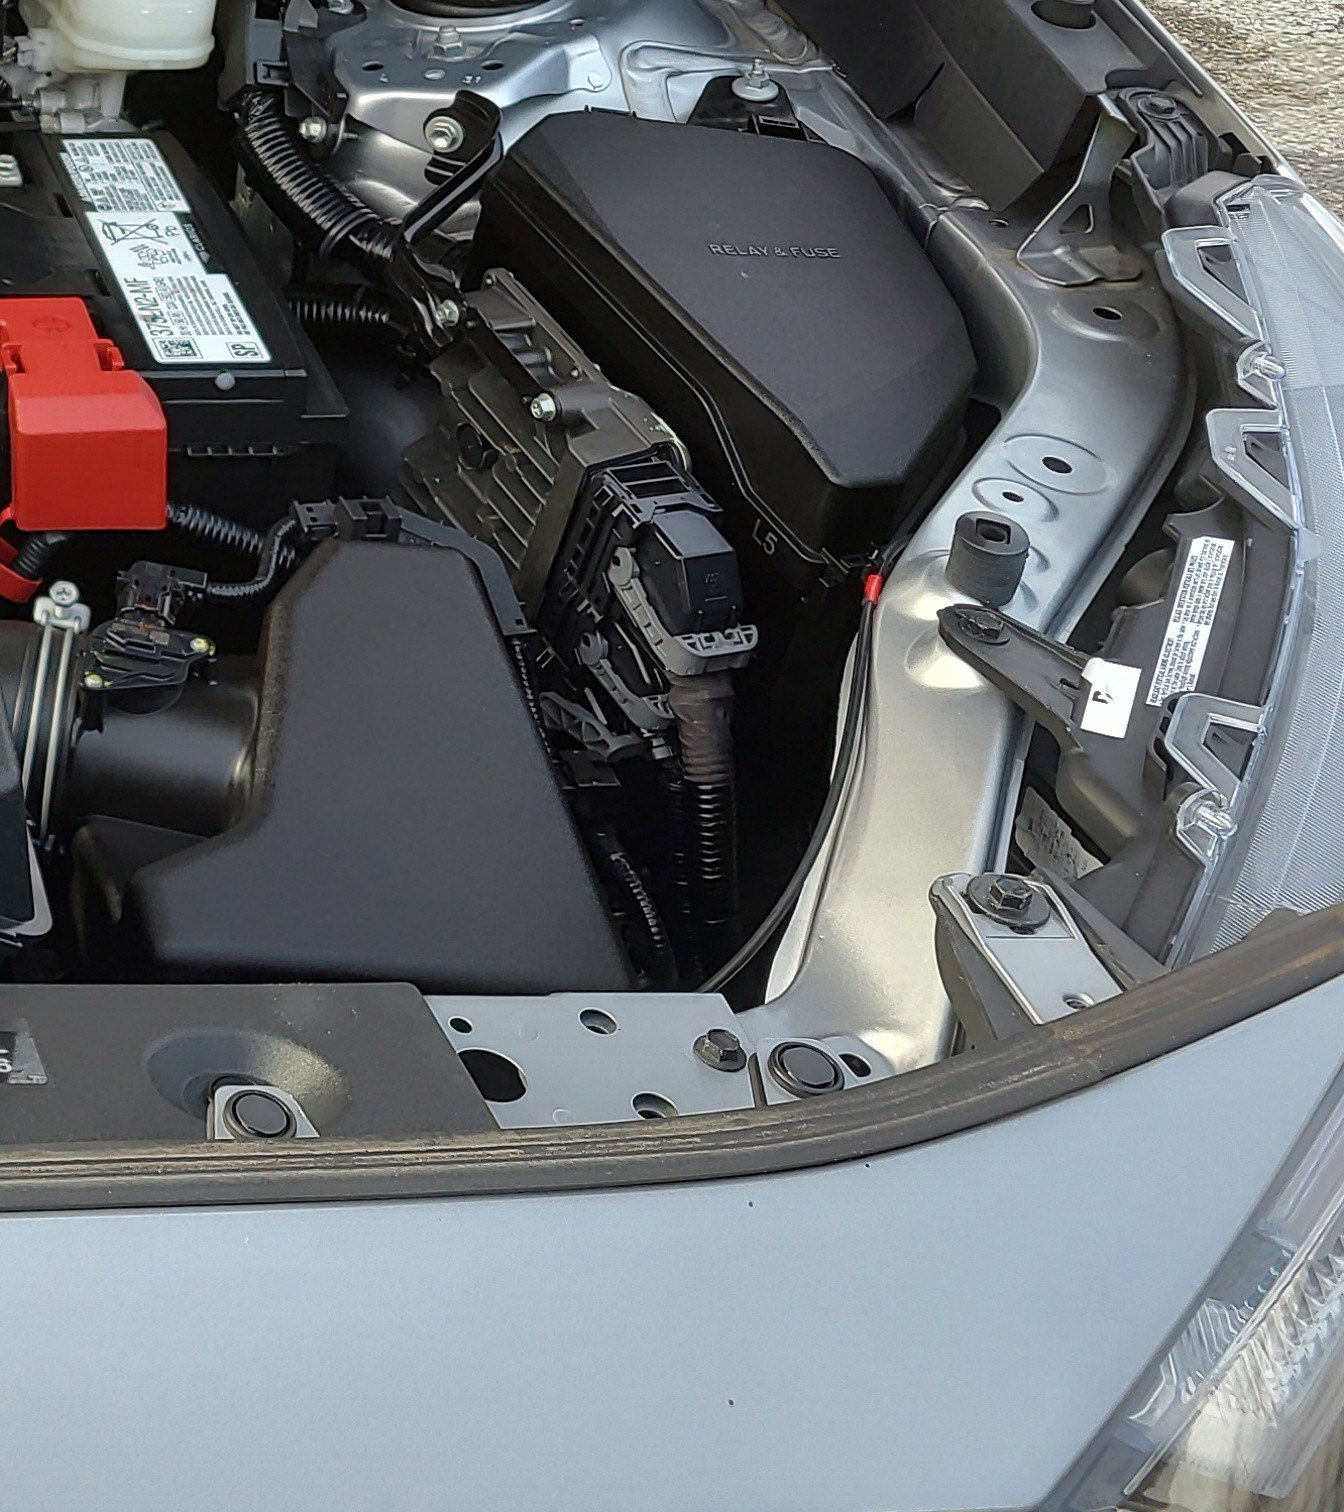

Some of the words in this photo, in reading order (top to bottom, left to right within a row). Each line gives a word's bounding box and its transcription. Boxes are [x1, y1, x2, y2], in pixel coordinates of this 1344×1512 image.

[708, 243, 768, 256] RELAY
[774, 246, 789, 257] &
[790, 246, 843, 259] FUSE
[230, 343, 260, 358] SP
[752, 518, 779, 555] L5
